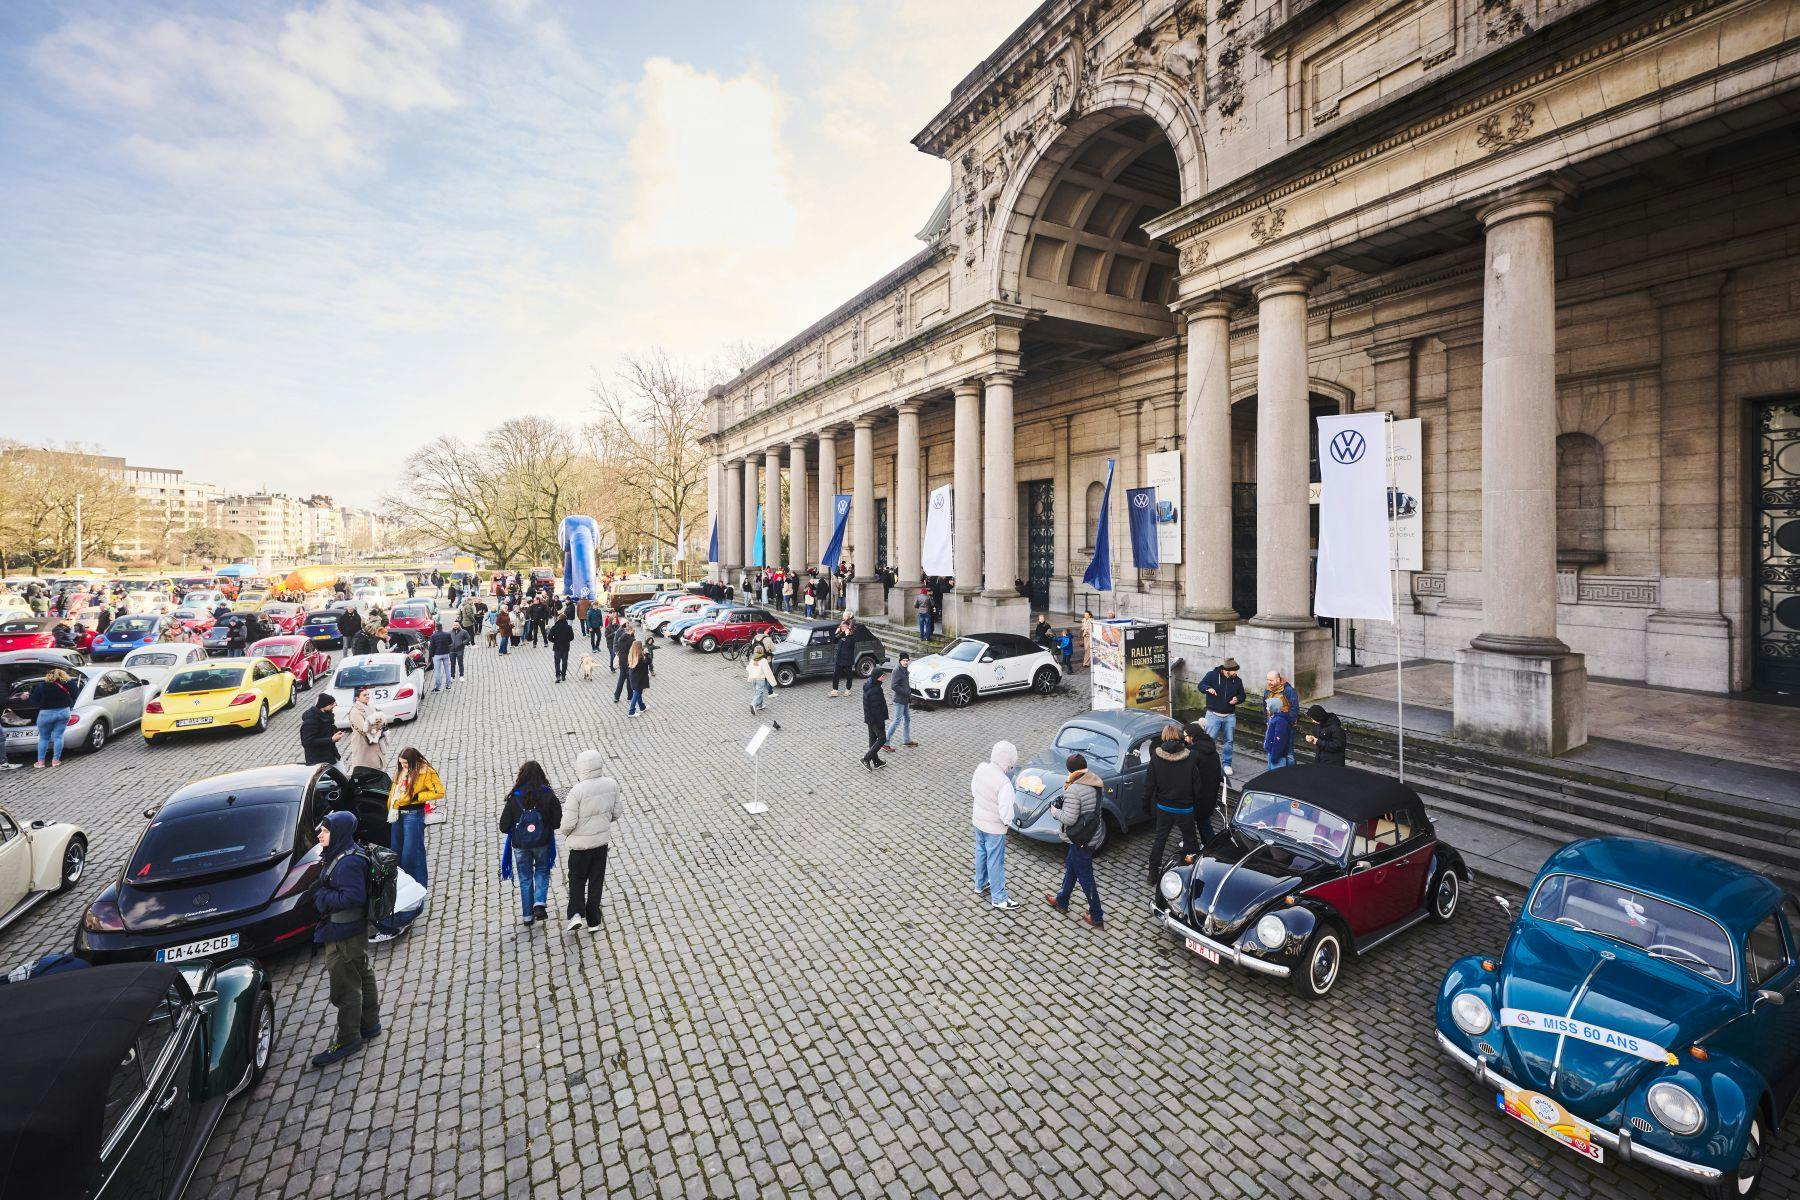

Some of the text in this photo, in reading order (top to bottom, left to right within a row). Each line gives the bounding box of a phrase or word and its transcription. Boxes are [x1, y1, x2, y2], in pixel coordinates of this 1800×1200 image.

[1330, 430, 1366, 464] VW
[1134, 493, 1149, 508] VW
[1131, 646, 1152, 658] RALLY
[1131, 656, 1153, 666] LEGENDS
[374, 689, 389, 700] 53
[167, 937, 228, 960] CA-442-CB
[1543, 1017, 1639, 1051] MISS 60 ANS
[1589, 1144, 1599, 1159] 3
